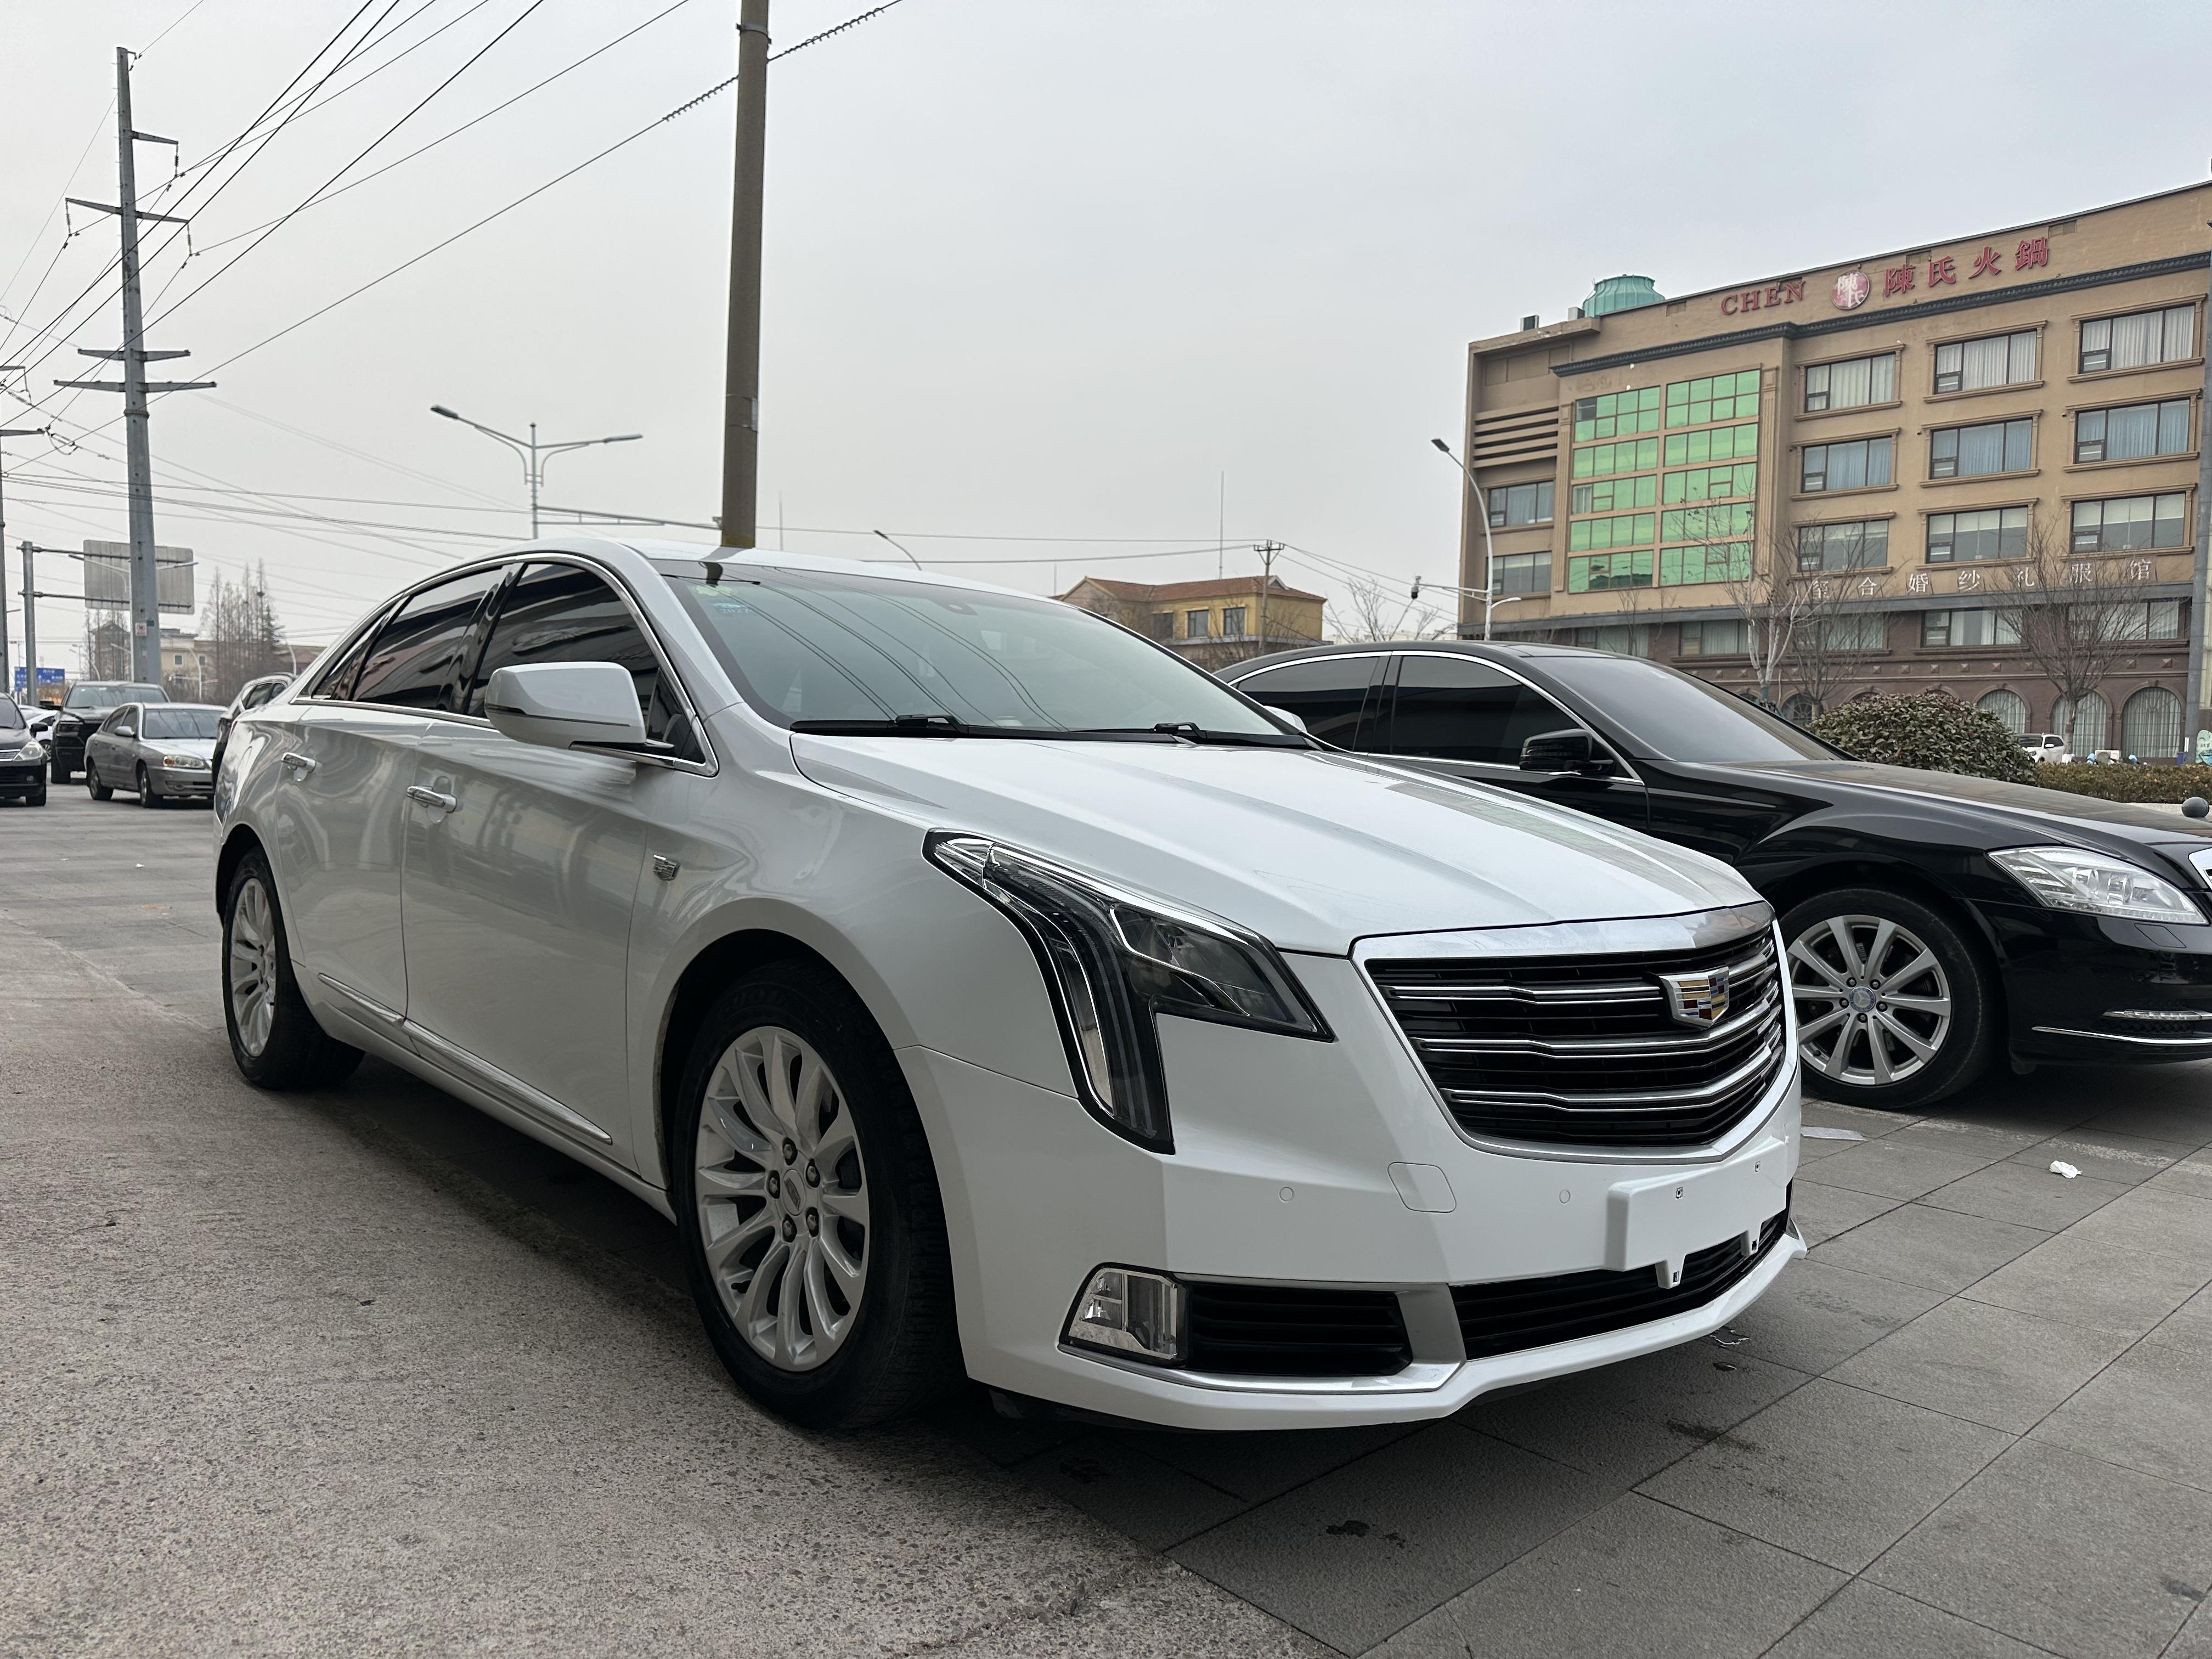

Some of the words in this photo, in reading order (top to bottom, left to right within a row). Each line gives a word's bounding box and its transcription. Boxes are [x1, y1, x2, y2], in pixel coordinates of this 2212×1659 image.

[1884, 237, 2049, 297] 陳氏火鍋
[1721, 280, 1805, 315] CHEN
